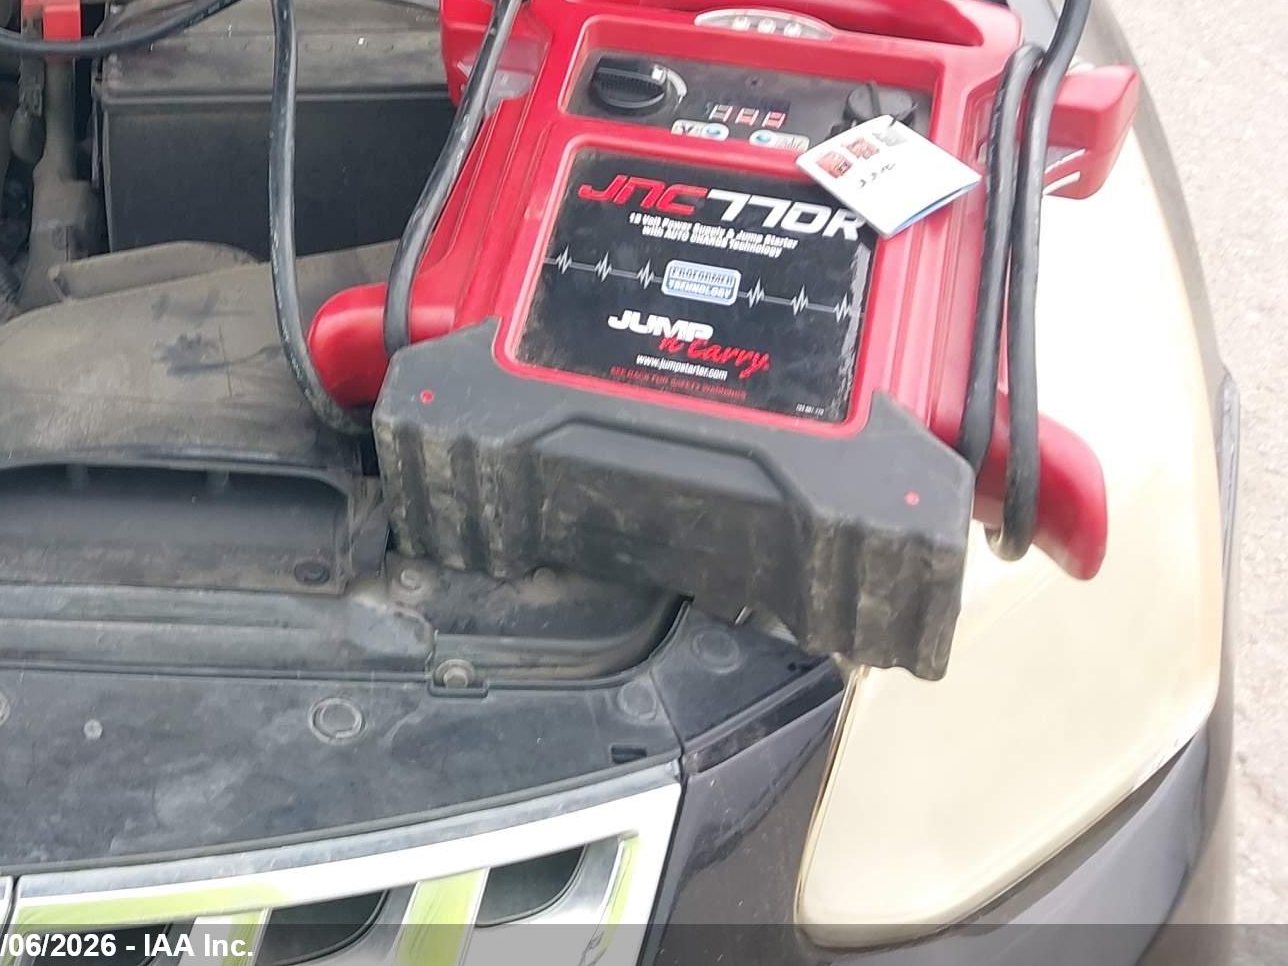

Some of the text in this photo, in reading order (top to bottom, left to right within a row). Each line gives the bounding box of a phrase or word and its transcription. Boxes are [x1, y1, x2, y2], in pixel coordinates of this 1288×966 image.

[642, 214, 662, 226] Volt
[662, 217, 693, 231] Power
[693, 222, 726, 237] Supply
[736, 229, 763, 243] Jump
[764, 234, 798, 249] Starter
[607, 309, 714, 342] JUMP
[636, 354, 728, 381] www.jumpstarter.com
